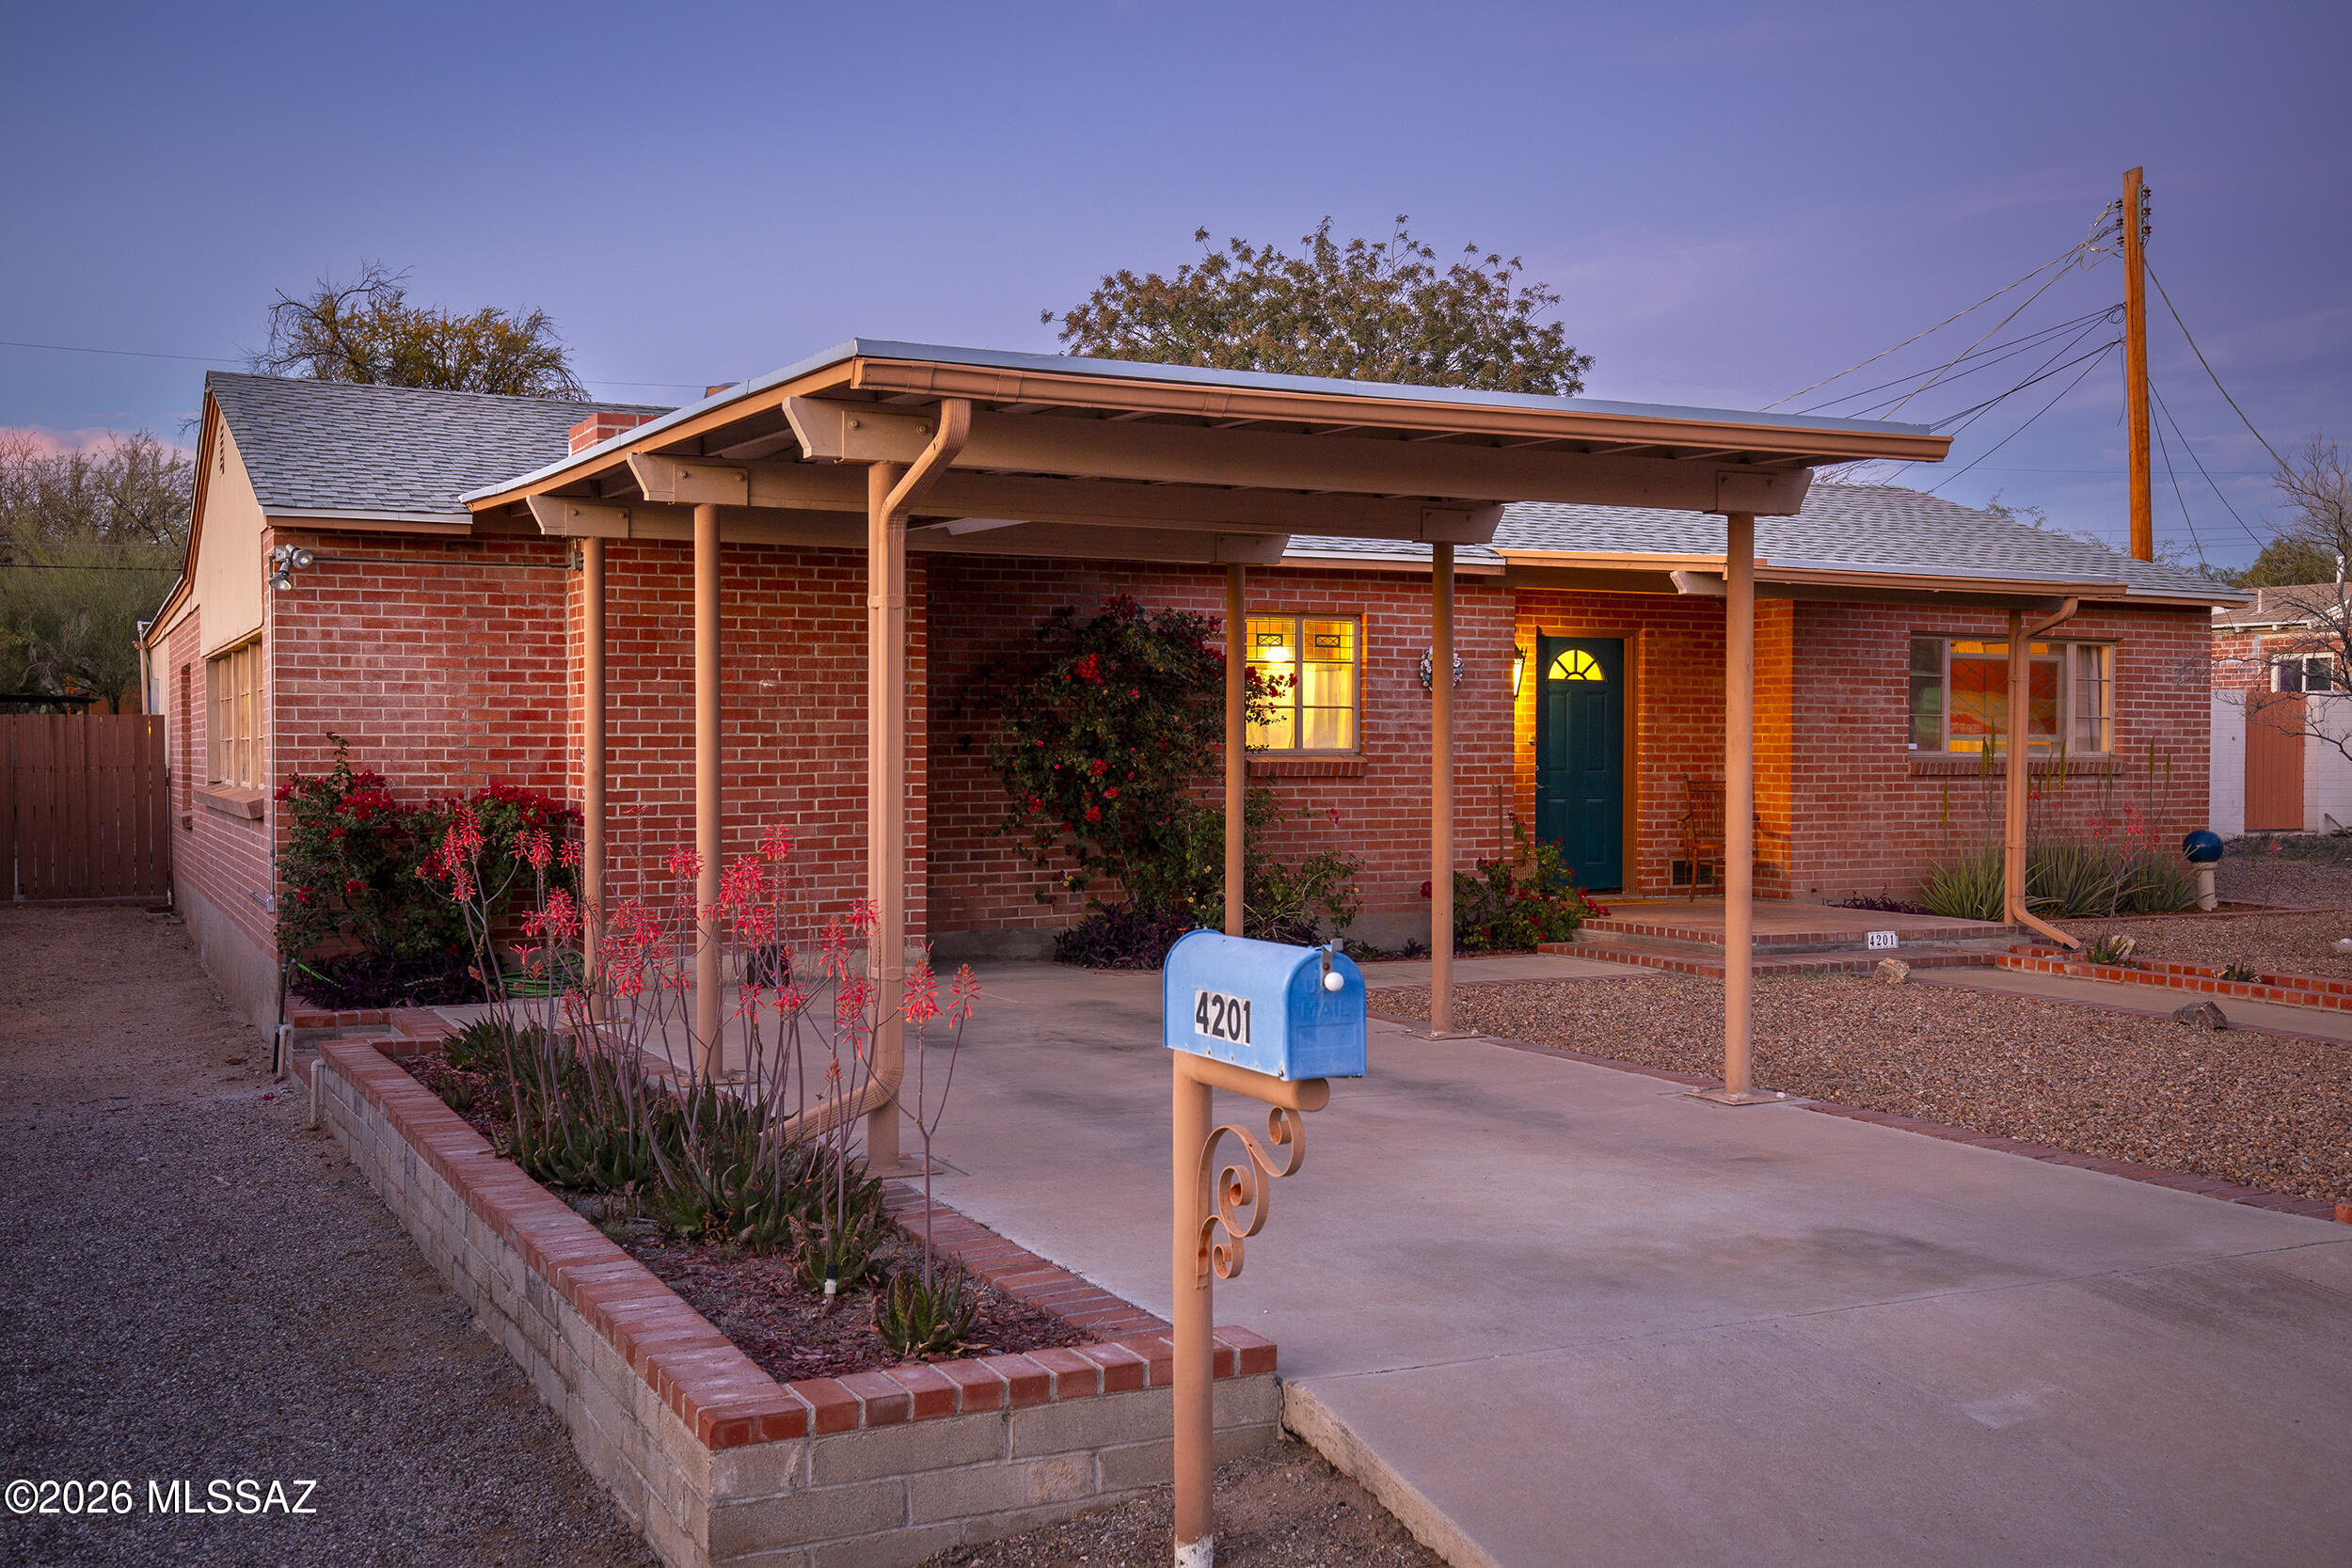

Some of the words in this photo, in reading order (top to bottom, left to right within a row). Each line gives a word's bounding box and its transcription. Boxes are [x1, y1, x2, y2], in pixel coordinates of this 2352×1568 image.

[1869, 934, 1895, 946] 4201
[1195, 991, 1251, 1044] 4201
[1300, 1000, 1349, 1019] MAIL
